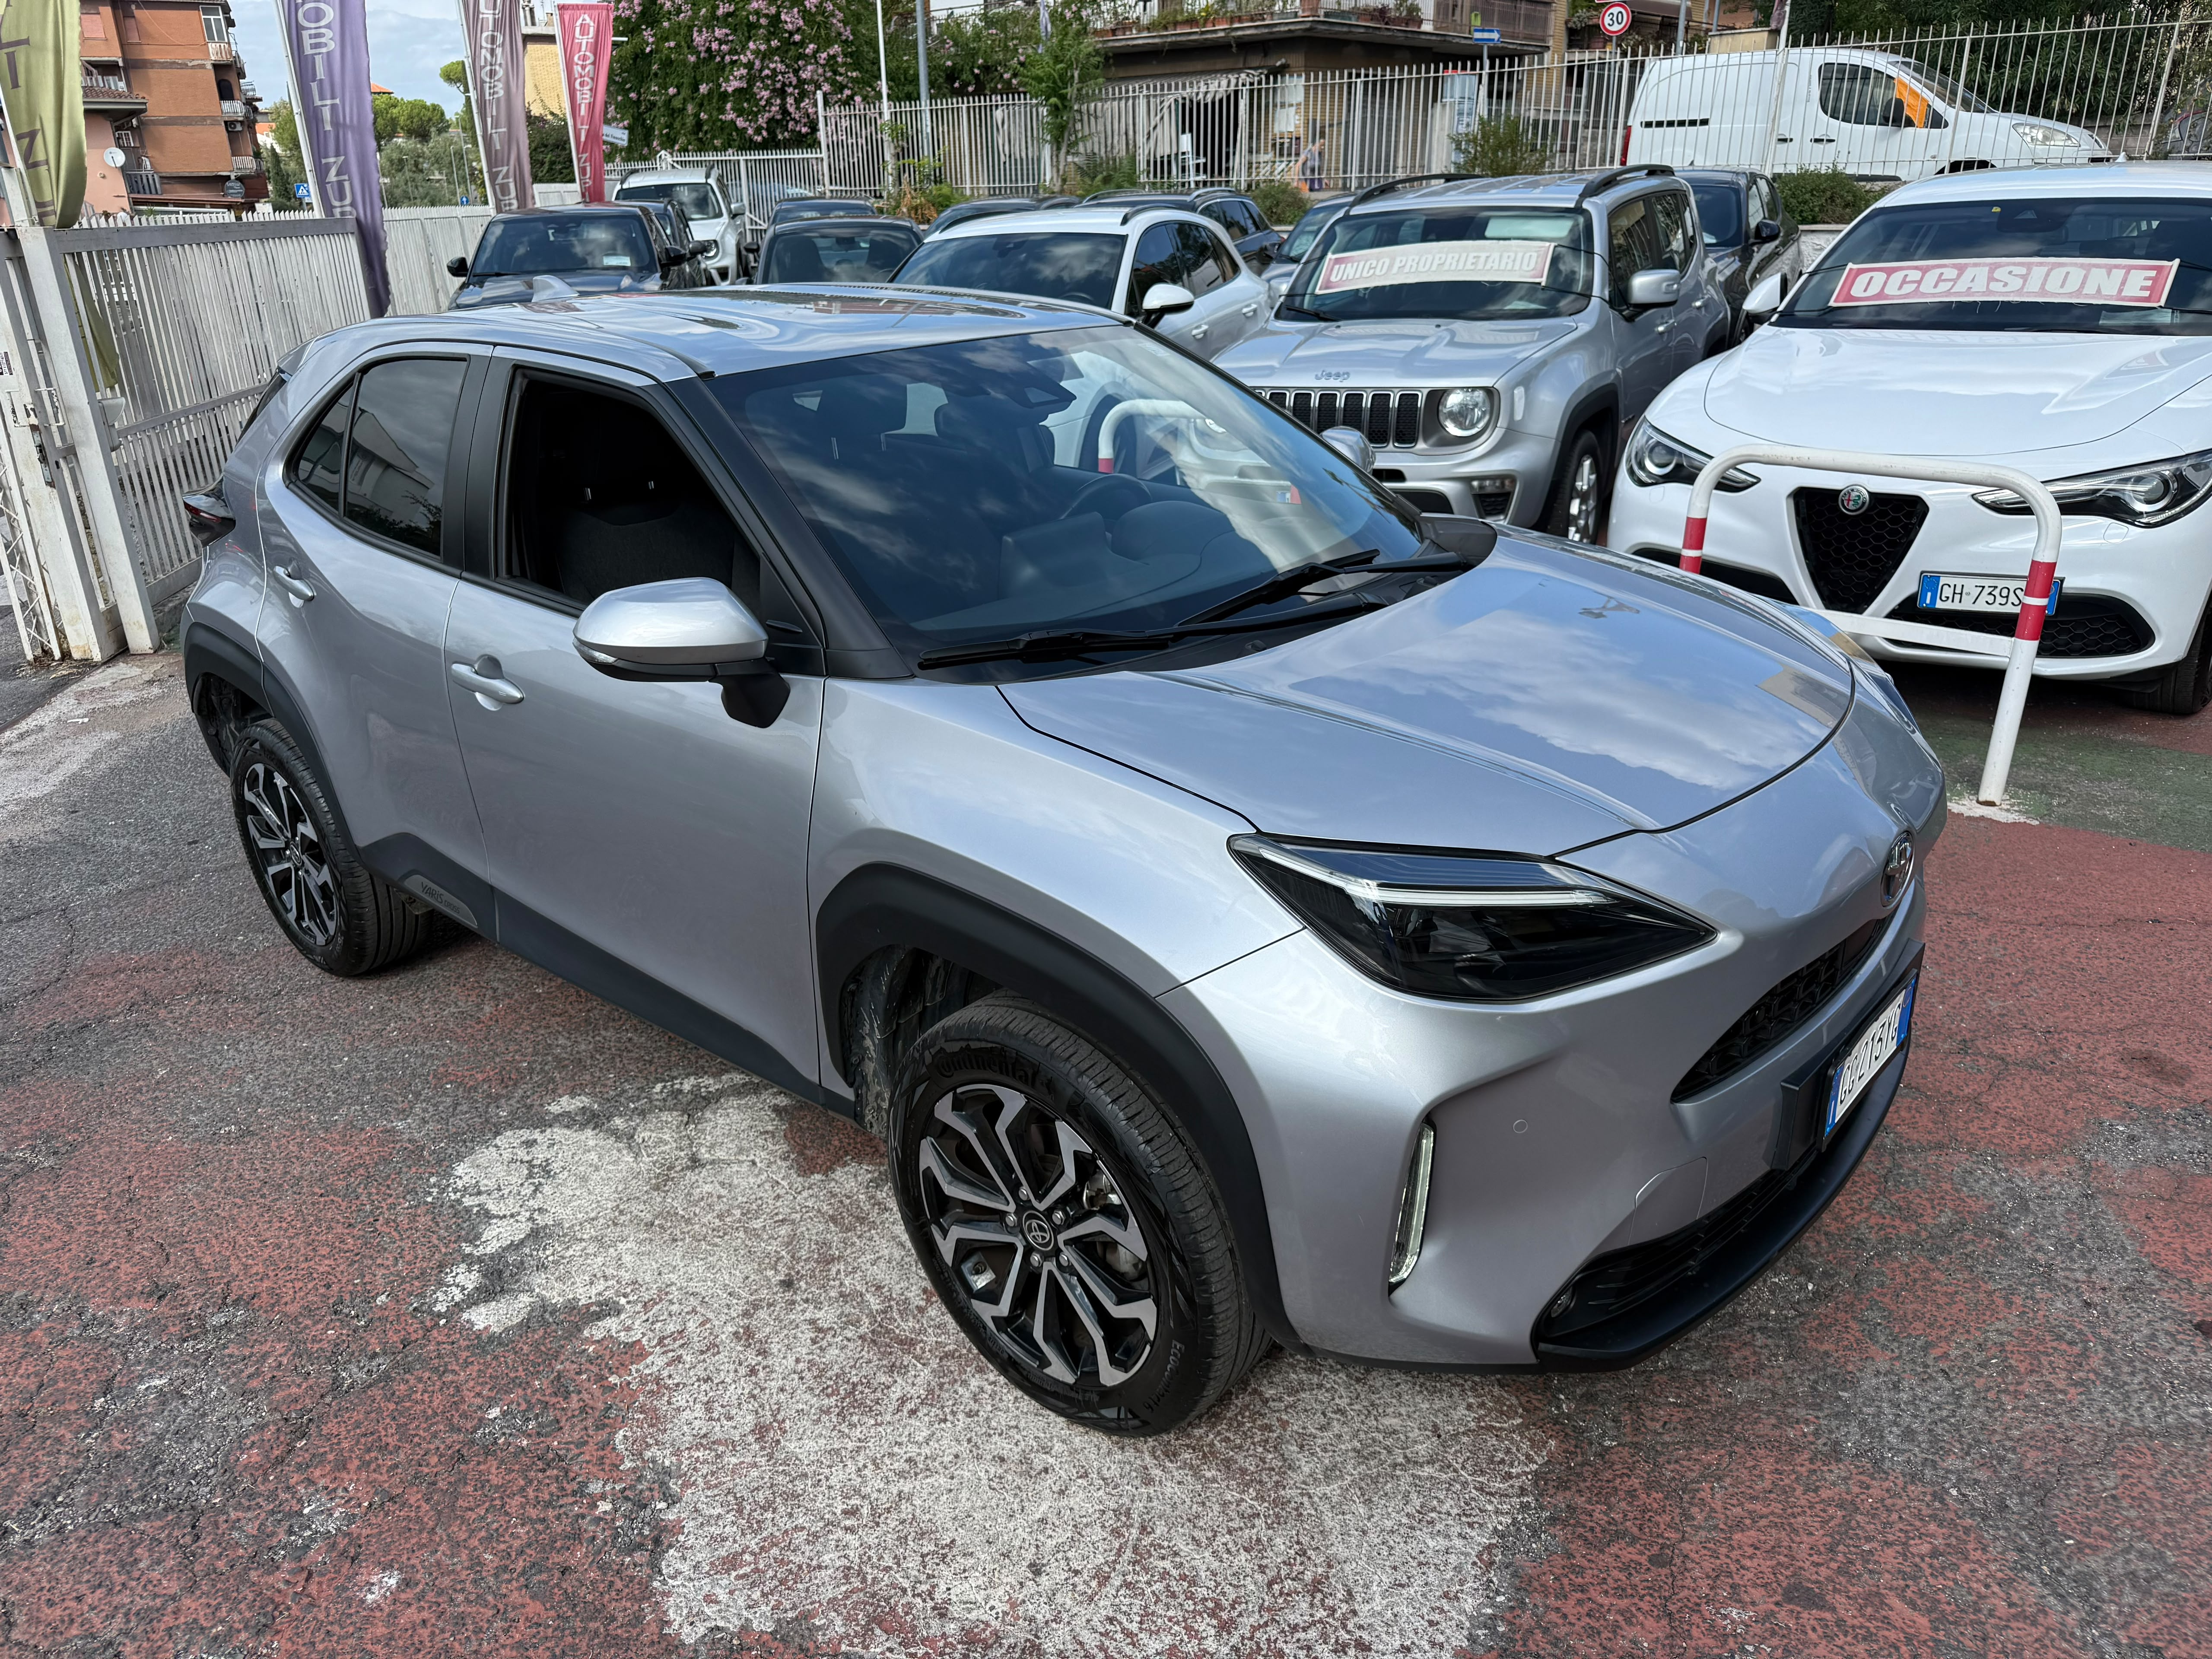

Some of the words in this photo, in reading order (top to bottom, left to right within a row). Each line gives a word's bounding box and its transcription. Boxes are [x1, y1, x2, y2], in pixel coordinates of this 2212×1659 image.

[1608, 11, 1624, 26] 30
[296, 0, 340, 131] OBILI
[574, 14, 595, 142] AUTOMOBILI
[1330, 258, 1389, 283] UNICO
[1392, 251, 1537, 274] PROPRIETARIO
[1850, 266, 2157, 297] OCCASIONE
[1315, 370, 1351, 382] Jeep
[1939, 583, 1964, 604] GH
[1972, 585, 2024, 607] 739S
[444, 900, 460, 914] CROSS
